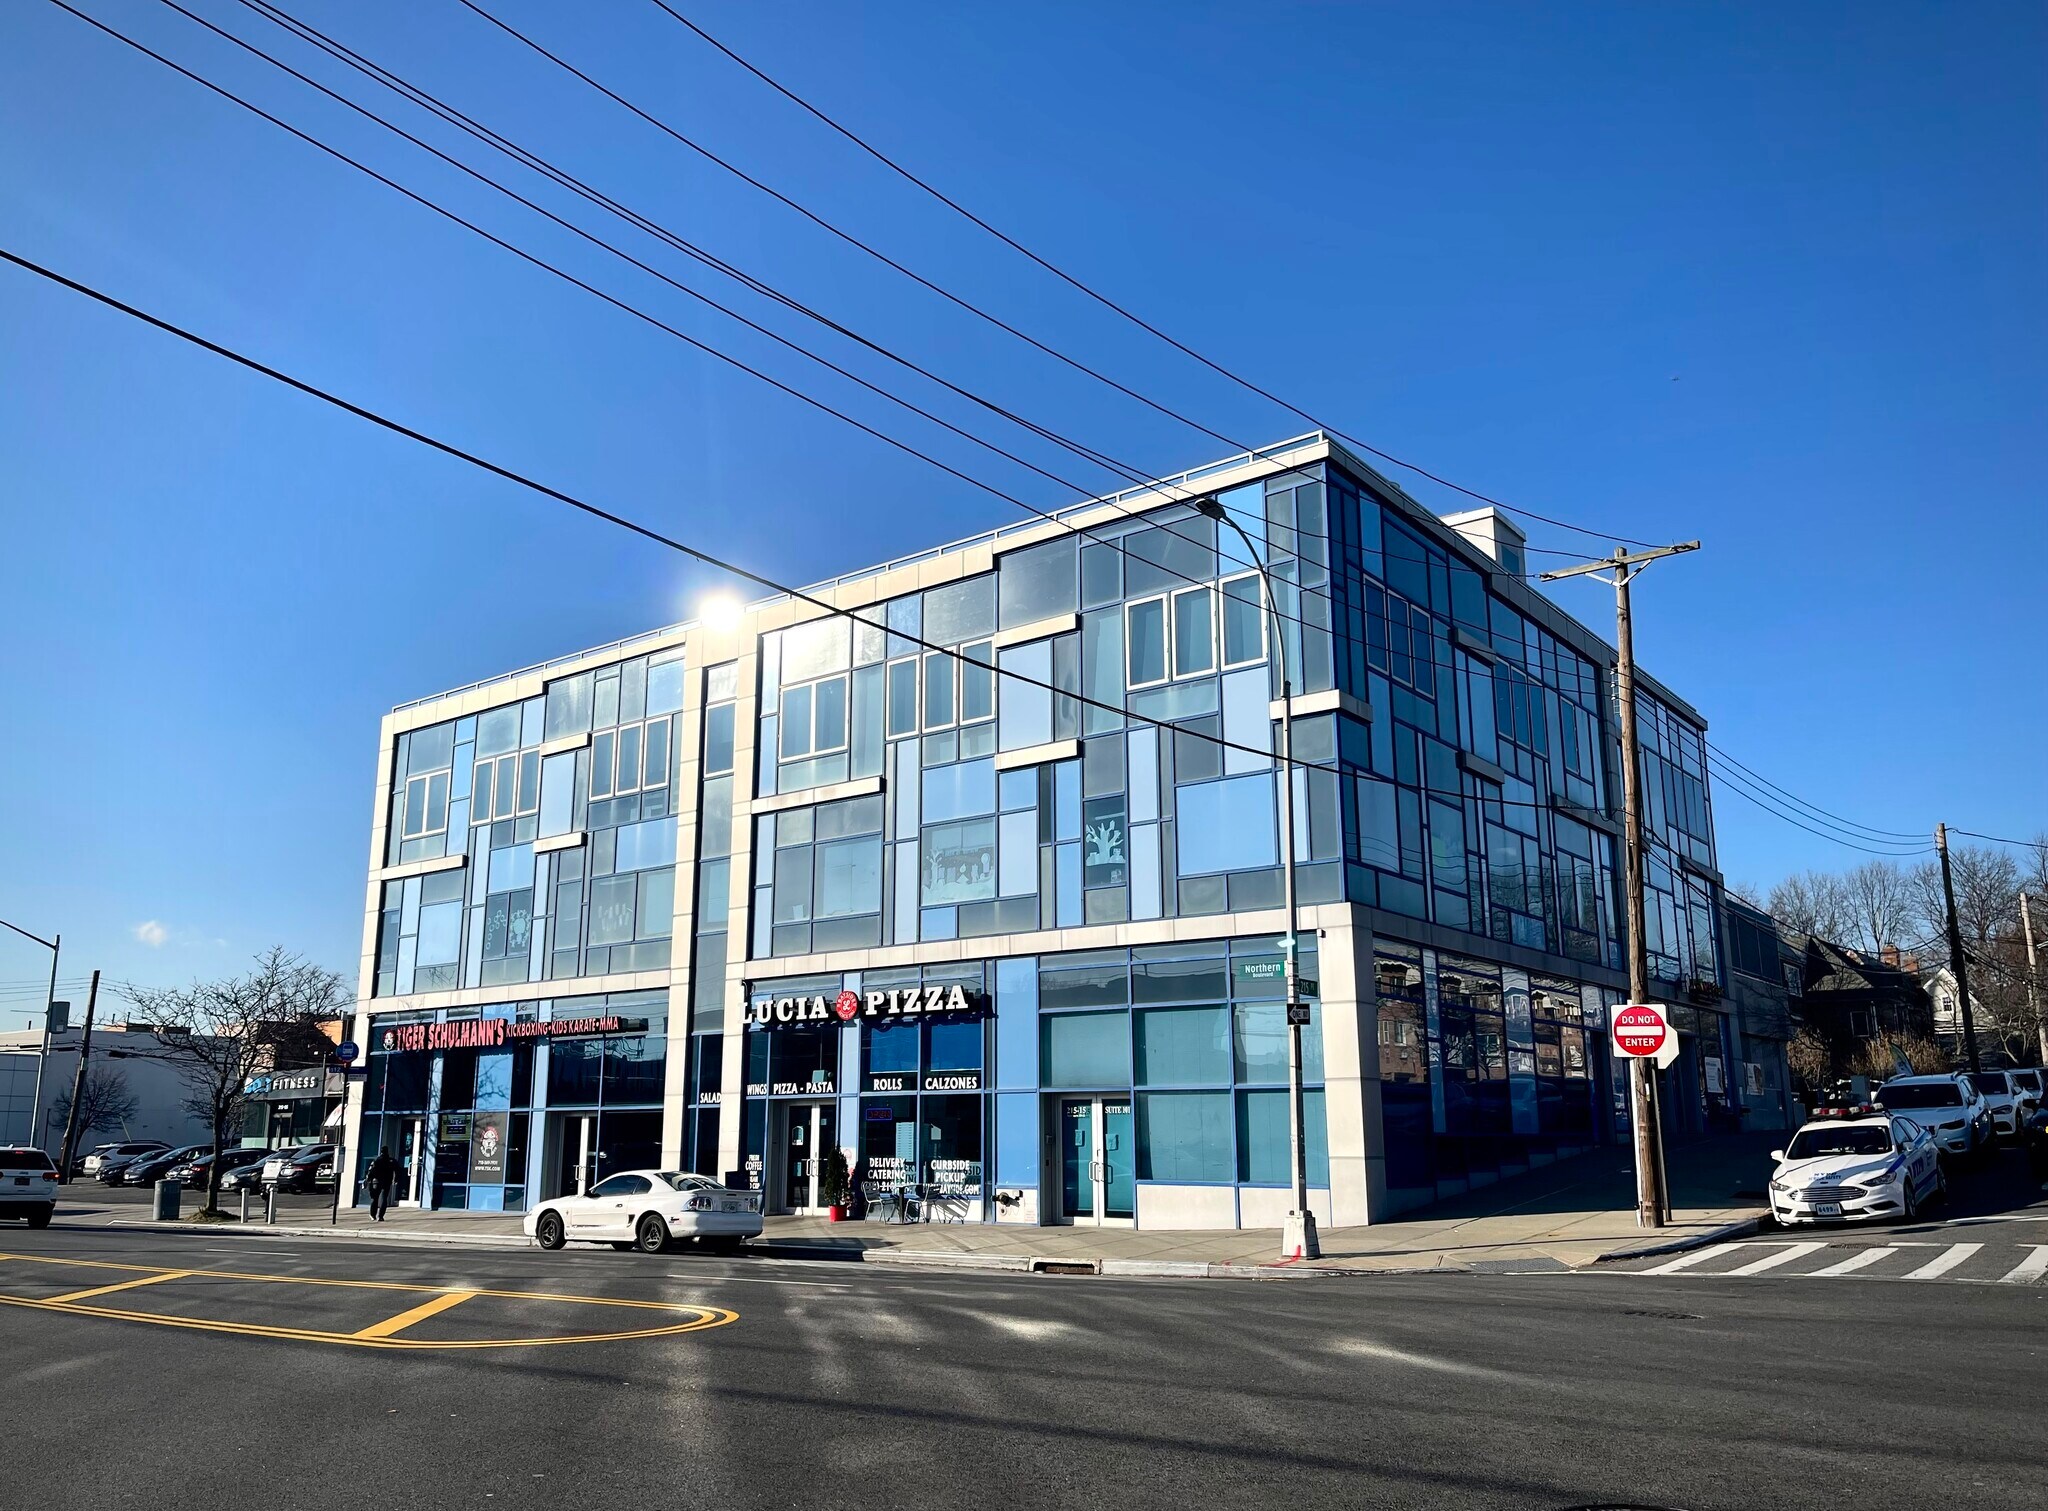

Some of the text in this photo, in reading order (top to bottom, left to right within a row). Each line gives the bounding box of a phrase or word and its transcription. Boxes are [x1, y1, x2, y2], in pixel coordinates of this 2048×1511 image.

[1244, 963, 1281, 974] Northern
[1300, 982, 1309, 994] 215
[740, 996, 829, 1024] LUCIA
[865, 985, 969, 1016] PIZZA
[1621, 1015, 1656, 1024] DO NOT
[505, 1016, 619, 1038] KICKBOXING KIDS KARATE MMA
[397, 1018, 505, 1051] TIGER SCHULMANN'S
[1625, 1037, 1656, 1047] ENTER
[272, 1076, 316, 1090] FITNESS
[746, 1084, 768, 1096] WINGS
[773, 1083, 798, 1095] PIZZA
[805, 1081, 834, 1094] PASTA
[873, 1076, 978, 1091] ROLLS CALZONES
[700, 1092, 721, 1104] SALAD
[1105, 1106, 1121, 1114] SUITE
[745, 1161, 763, 1171] COFFEE
[869, 1158, 906, 1168] DELIVERY
[930, 1159, 971, 1171] CURBSIDE
[867, 1169, 906, 1180] CATERING
[935, 1172, 965, 1183] PICKUP
